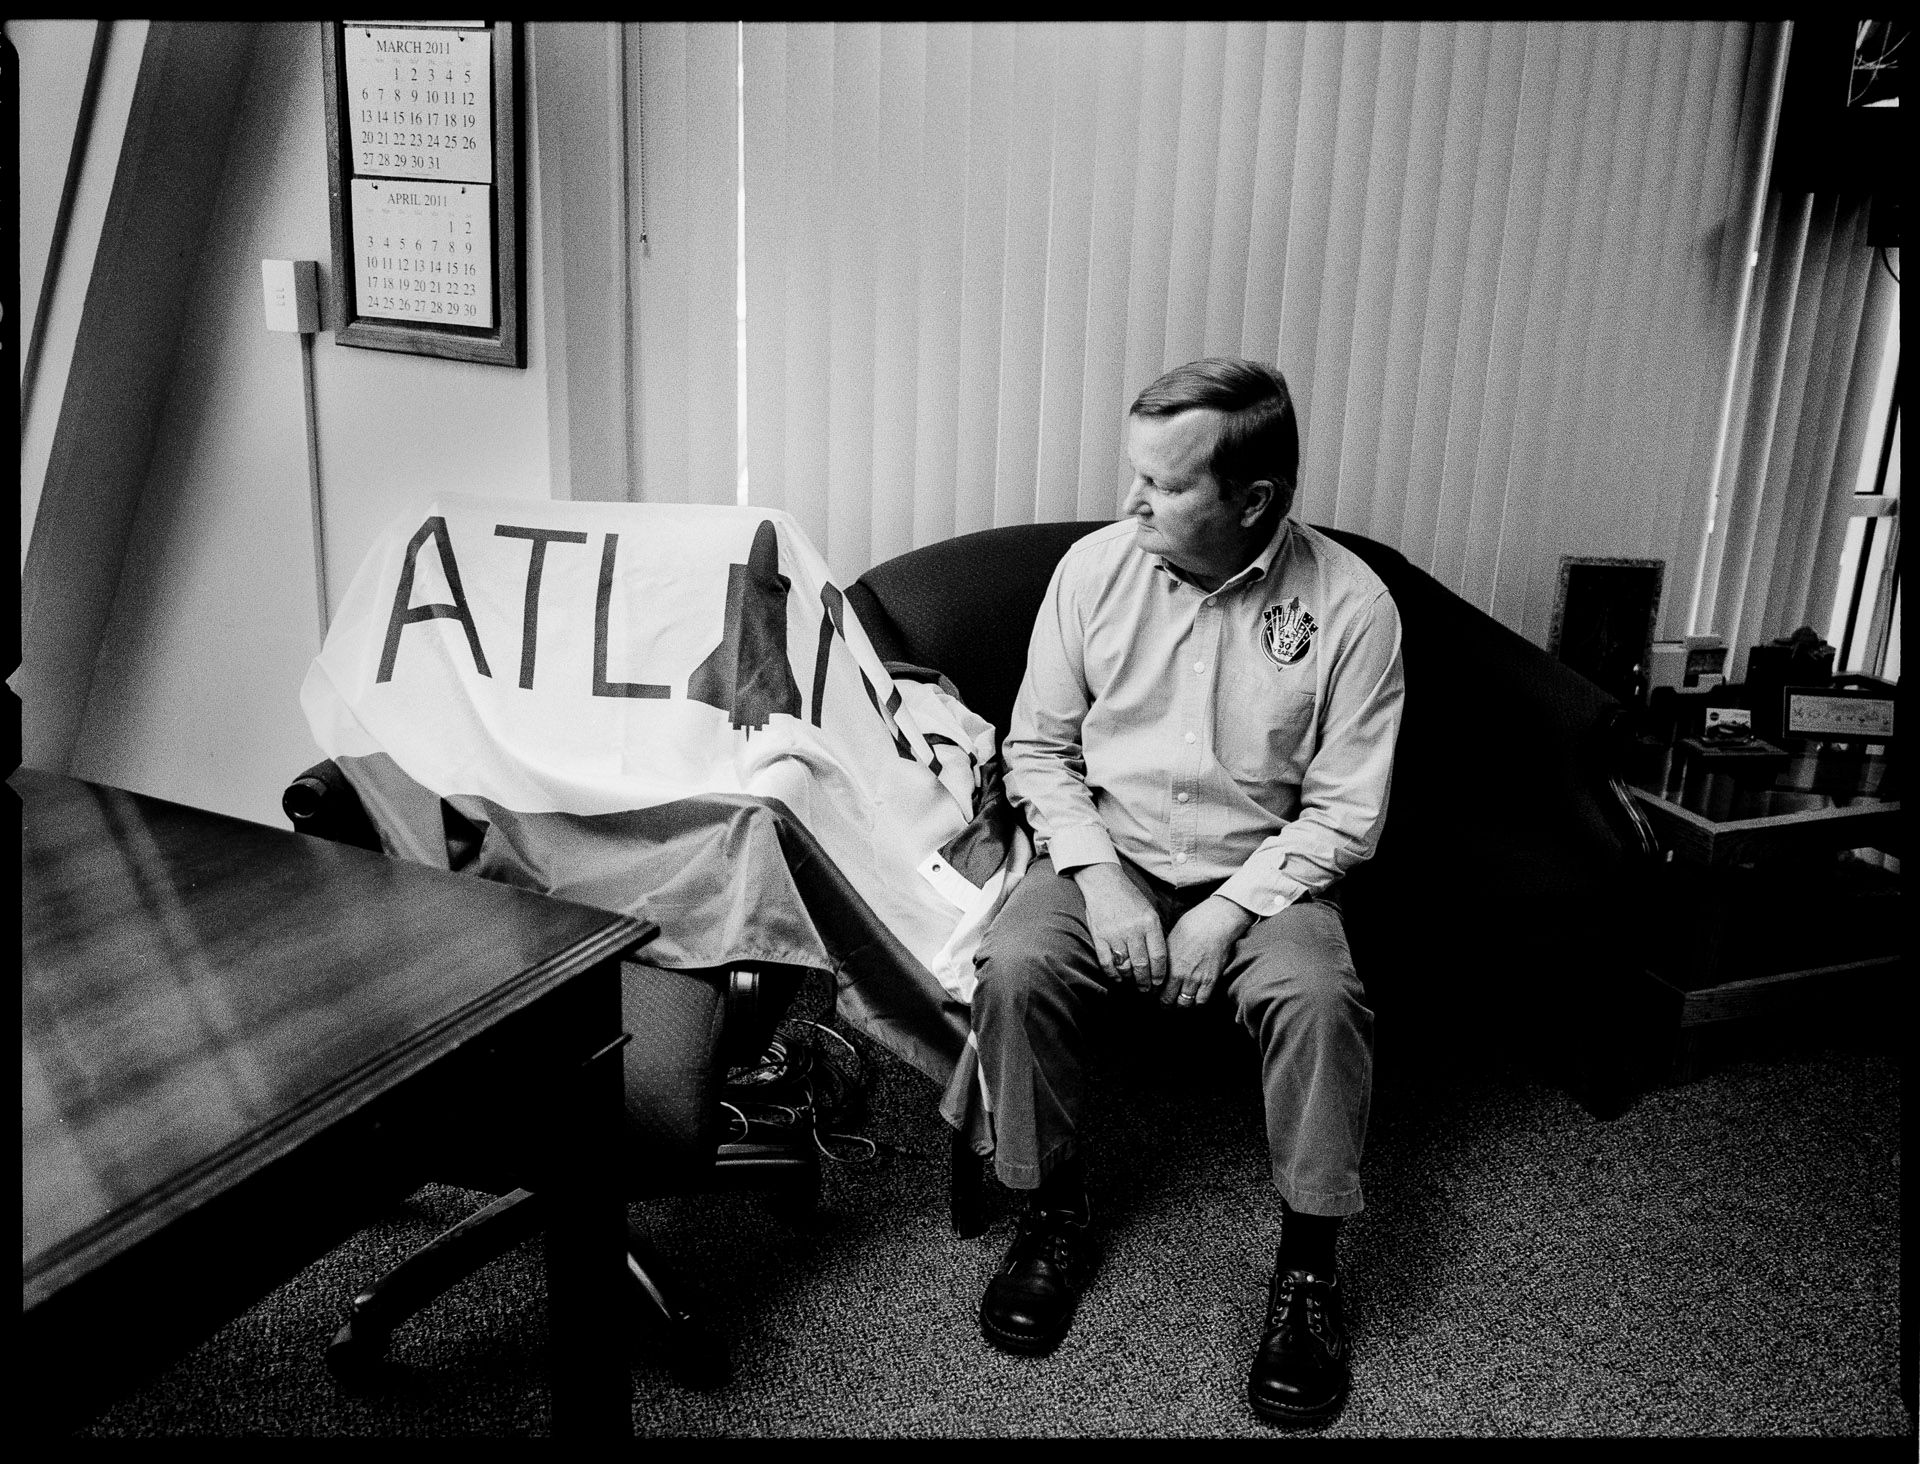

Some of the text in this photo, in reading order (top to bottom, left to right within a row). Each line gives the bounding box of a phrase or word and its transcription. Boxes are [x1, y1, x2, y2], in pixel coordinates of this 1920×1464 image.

[376, 40, 450, 55] MARCH 2011
[426, 91, 439, 103] 10
[444, 92, 455, 104] 11
[462, 92, 475, 105] 12
[361, 110, 476, 127] 13 14 15 16 17 18 19
[361, 131, 477, 149] 20 21 22 23 24 25 26
[362, 152, 440, 169] 27 28 29 30 31
[388, 192, 448, 208] APRIL 2011
[367, 256, 476, 276] 10 11 12 13 14 15 16
[368, 276, 476, 296] 17 18 19 20 21 22 23
[368, 295, 477, 317] 24 25 26 27 28 29 30
